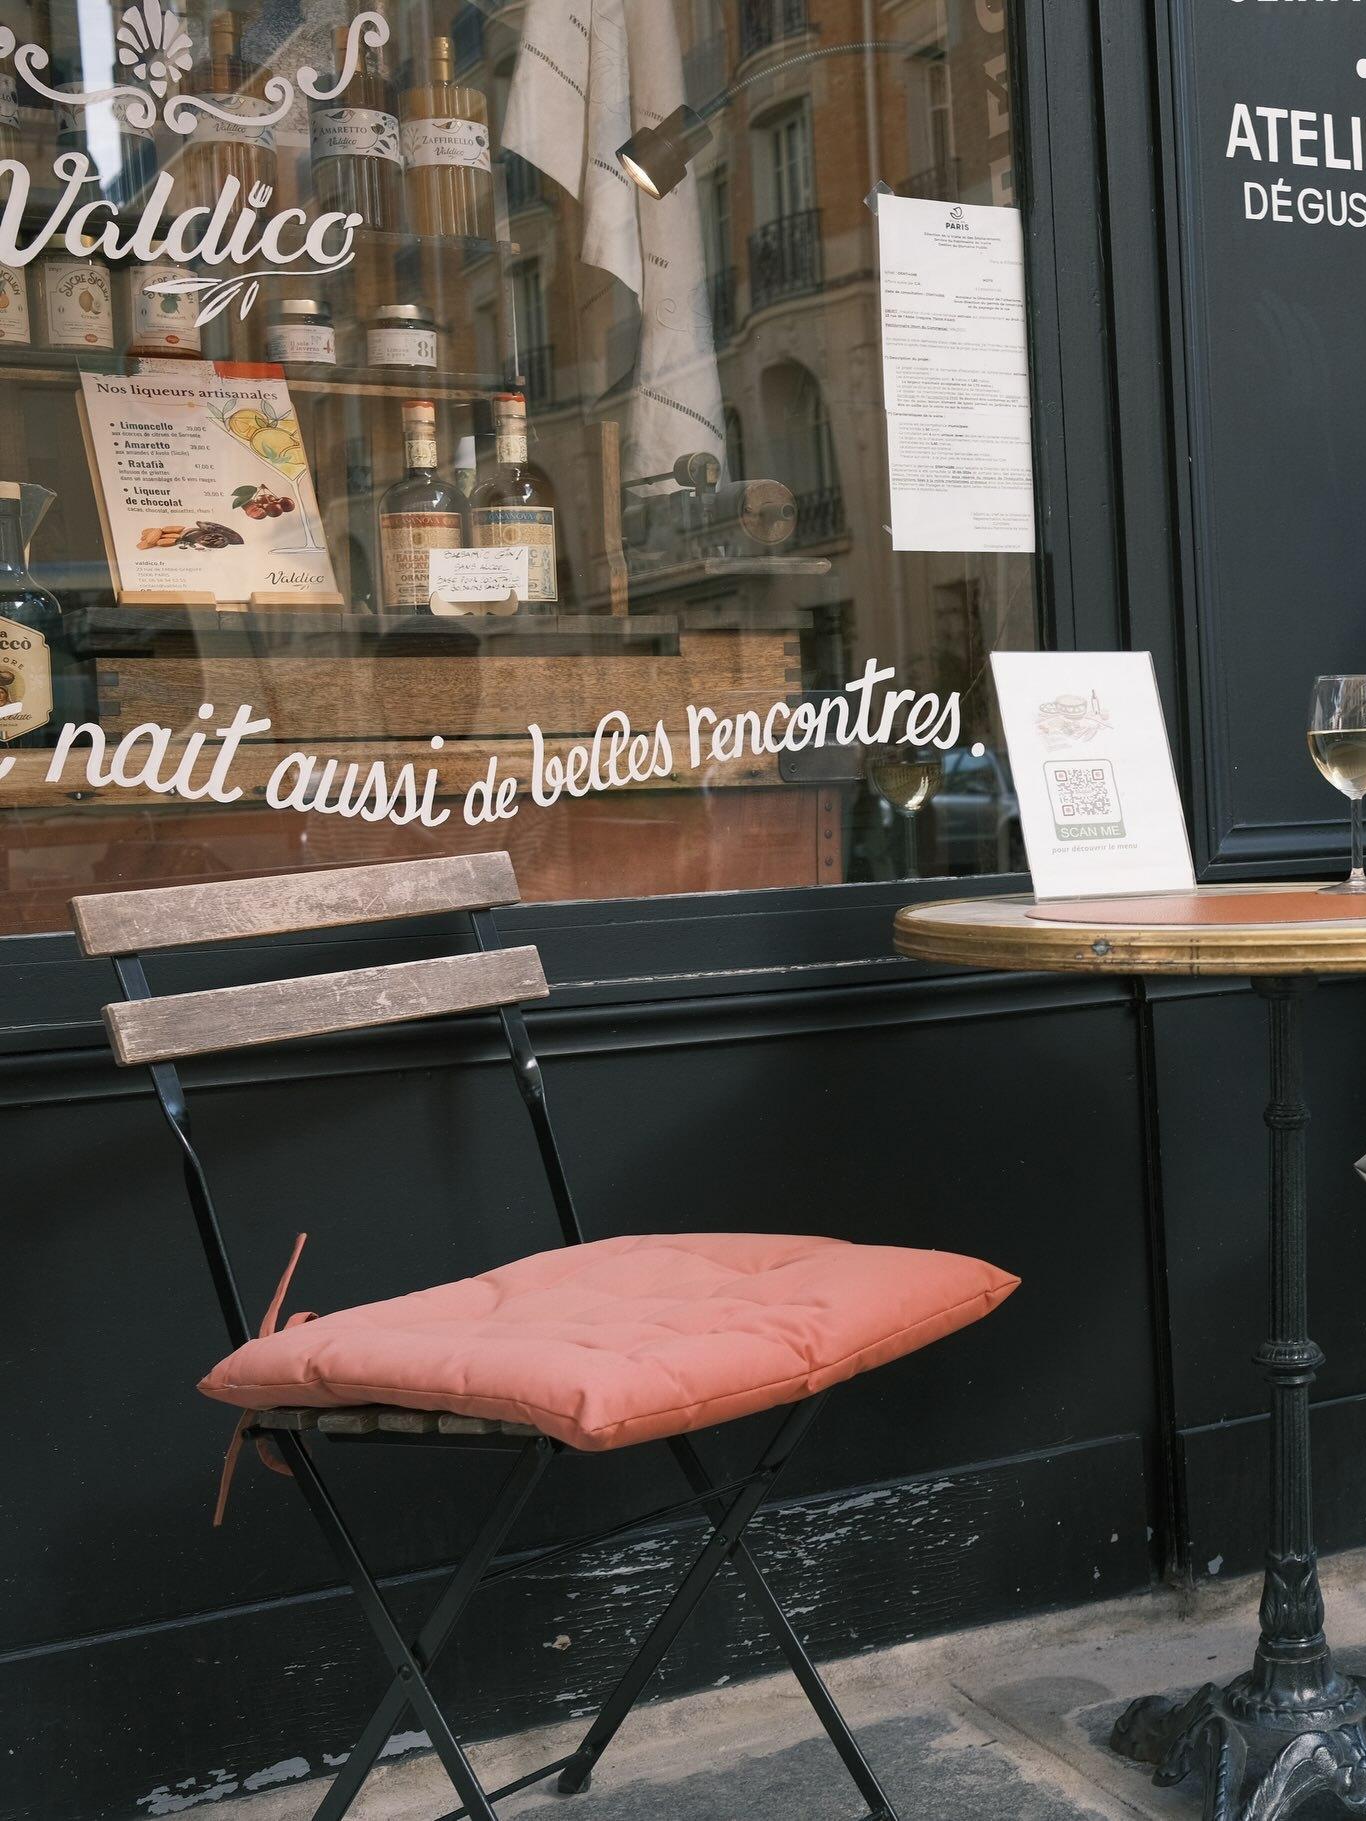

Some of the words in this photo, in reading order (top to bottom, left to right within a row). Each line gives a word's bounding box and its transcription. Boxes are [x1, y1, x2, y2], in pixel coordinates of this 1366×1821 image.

[319, 126, 367, 135] AMARETTO
[327, 137, 358, 147] Valdico
[422, 136, 474, 146] ZAFFIRELLO
[433, 147, 465, 156] Valdico
[0, 152, 363, 268] Valdico
[945, 222, 970, 231] PARIS
[59, 274, 87, 297] SUCRE
[96, 383, 127, 394] Nos
[131, 384, 195, 398] liqueurs
[198, 388, 278, 400] artisanales
[120, 421, 174, 431] Limoncello
[124, 440, 171, 449] Amaretto
[128, 459, 165, 469] Ratafià
[133, 486, 171, 496] Liqueur
[125, 497, 138, 505] de
[140, 498, 183, 507] chocolat
[265, 571, 324, 585] Valdico
[0, 637, 32, 650] ccò
[46, 704, 271, 802] nait
[266, 736, 450, 826] aussi
[464, 756, 518, 825] de
[528, 711, 672, 807] belles
[688, 658, 984, 767] rencontres.
[1060, 826, 1098, 838] SCAN
[1100, 825, 1119, 837] ME
[1052, 847, 1069, 855] pour
[1071, 844, 1107, 853] découvrir
